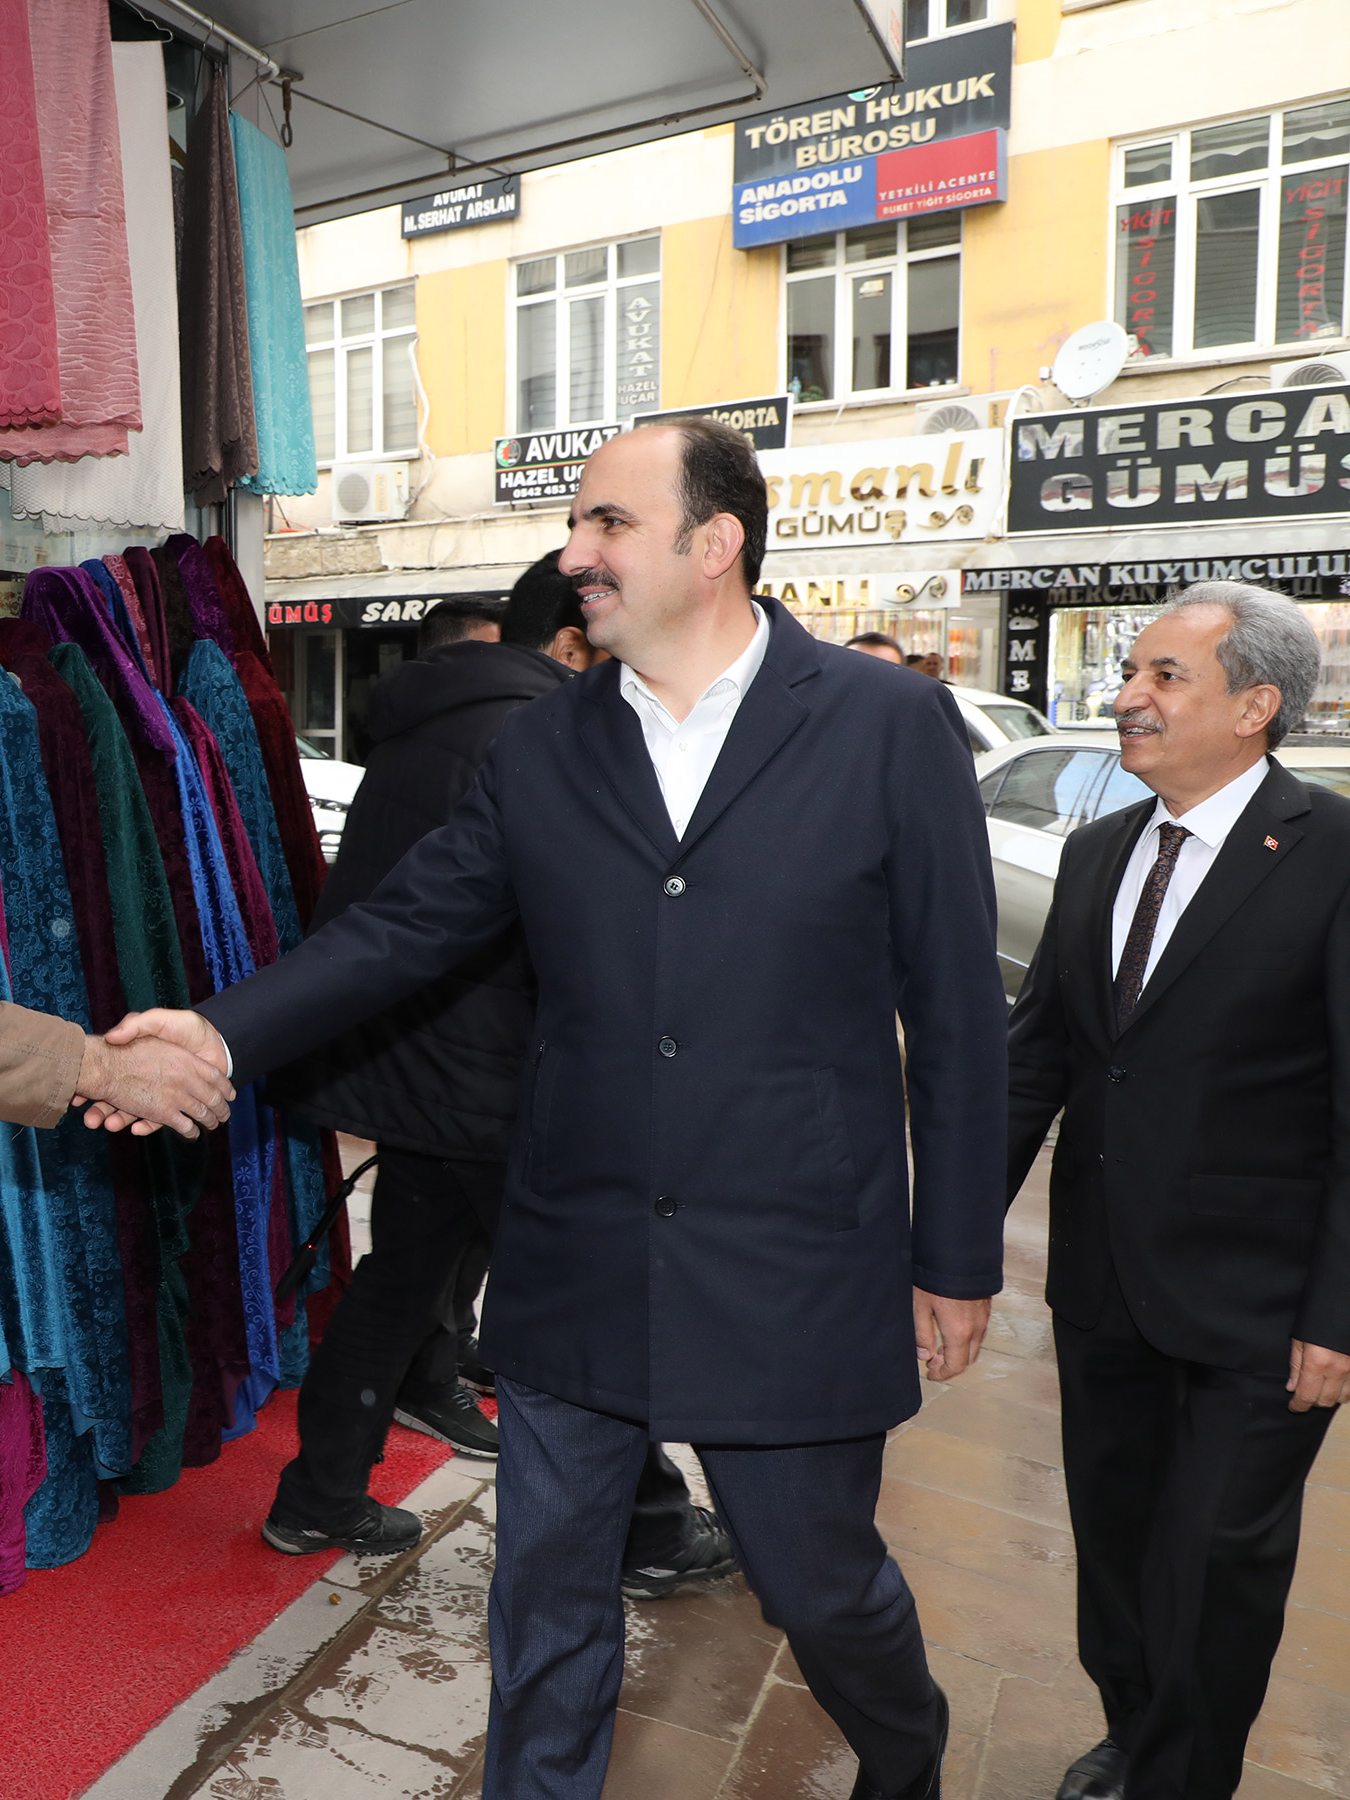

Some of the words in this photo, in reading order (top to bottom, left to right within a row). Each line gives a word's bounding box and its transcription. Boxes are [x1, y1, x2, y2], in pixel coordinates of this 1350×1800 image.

[745, 105, 856, 149] TÖREN
[866, 72, 996, 124] HUKUK
[795, 117, 937, 169] BÜROSU
[739, 164, 862, 205] ANADOLU
[879, 181, 933, 202] YETKİLİ
[938, 170, 995, 190] ACENTE
[946, 187, 992, 203] SİGORTA
[466, 194, 515, 220] ARSLAN
[739, 189, 848, 224] SİGORTA
[625, 296, 654, 377] AVUKAT
[618, 380, 657, 394] HAZEL
[620, 392, 655, 405] UÇAR
[702, 406, 780, 429] İGORTA
[1017, 393, 1350, 463] MERCA
[525, 428, 619, 462] AVUKAT
[500, 468, 559, 489] HAZEL
[513, 486, 542, 499] 0542
[544, 484, 566, 496] 453
[776, 505, 907, 539] GÜMÜŞ
[965, 565, 1101, 592] MERCAN
[1108, 554, 1350, 586] KUYUMCULU
[266, 601, 332, 624] ÜMÜŞ
